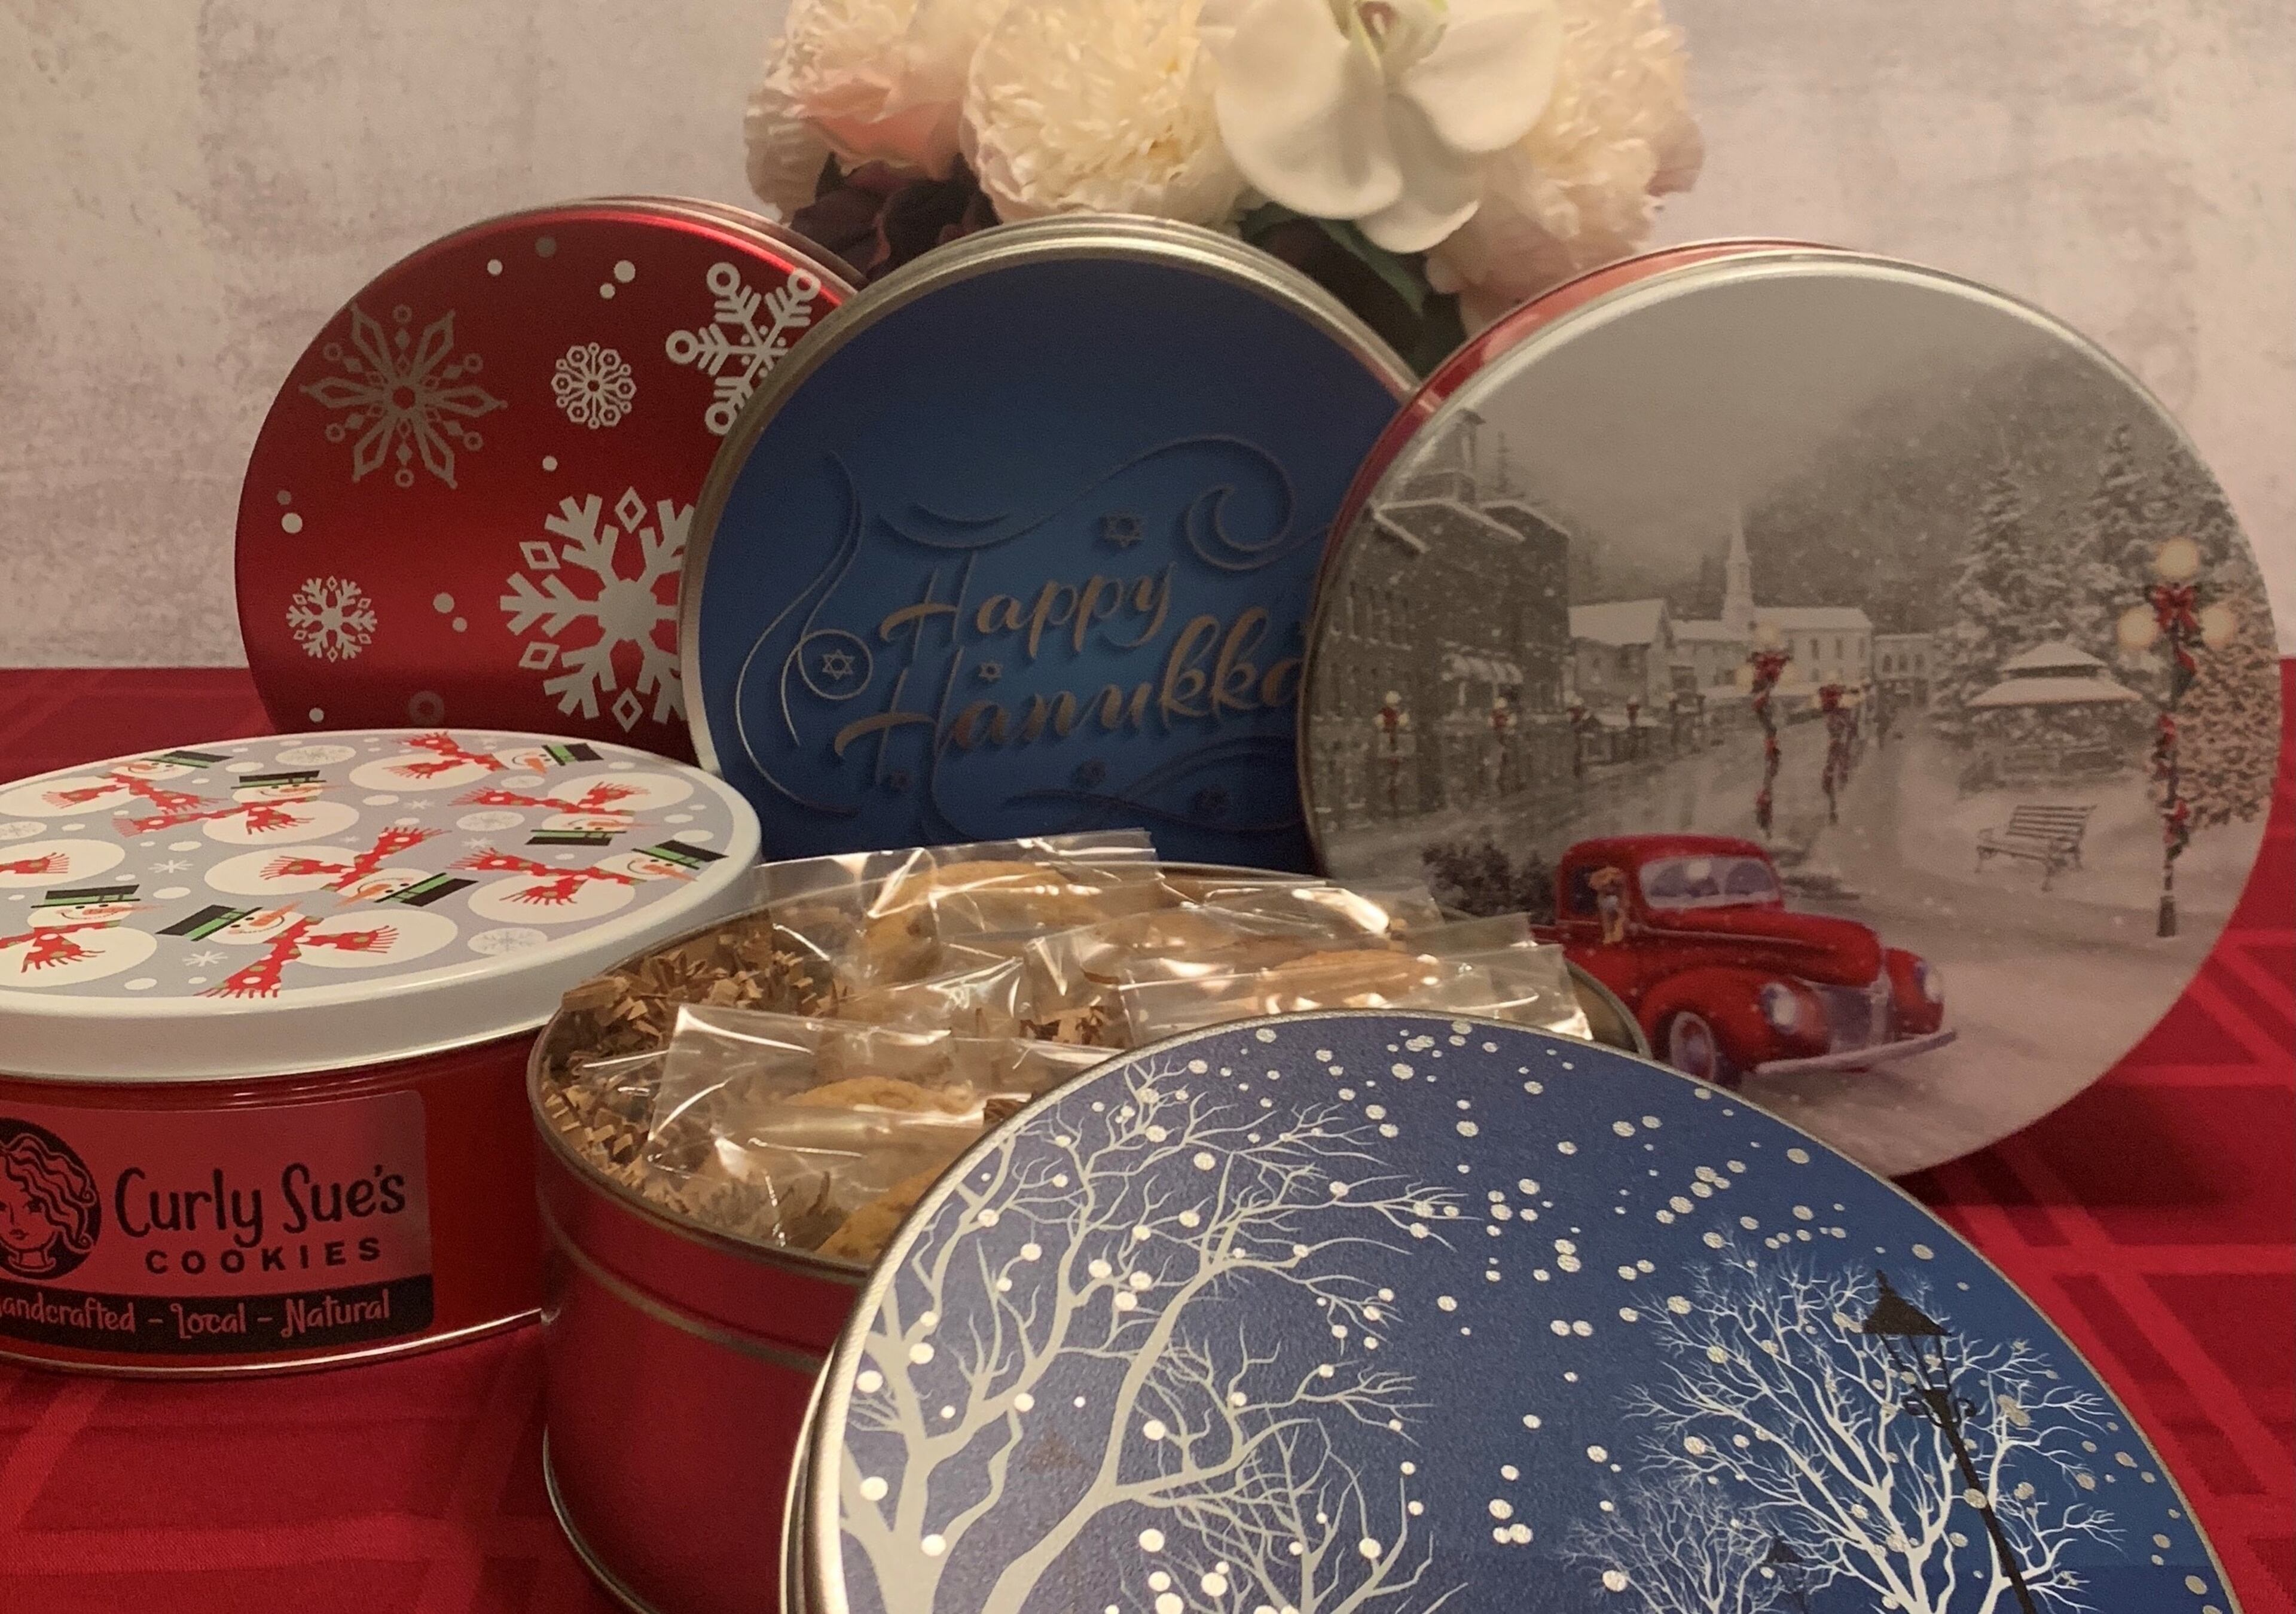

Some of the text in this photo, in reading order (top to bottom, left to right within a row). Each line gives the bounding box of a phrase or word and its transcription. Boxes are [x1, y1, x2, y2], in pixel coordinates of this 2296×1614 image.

[879, 550, 1178, 665] Happy
[834, 606, 1304, 785] Hanukka
[115, 1163, 407, 1249] Curly Sue's
[145, 1237, 381, 1274] COOKIES
[0, 1291, 136, 1334] andcrafted
[170, 1302, 246, 1339] Local
[281, 1288, 390, 1338] Natural
